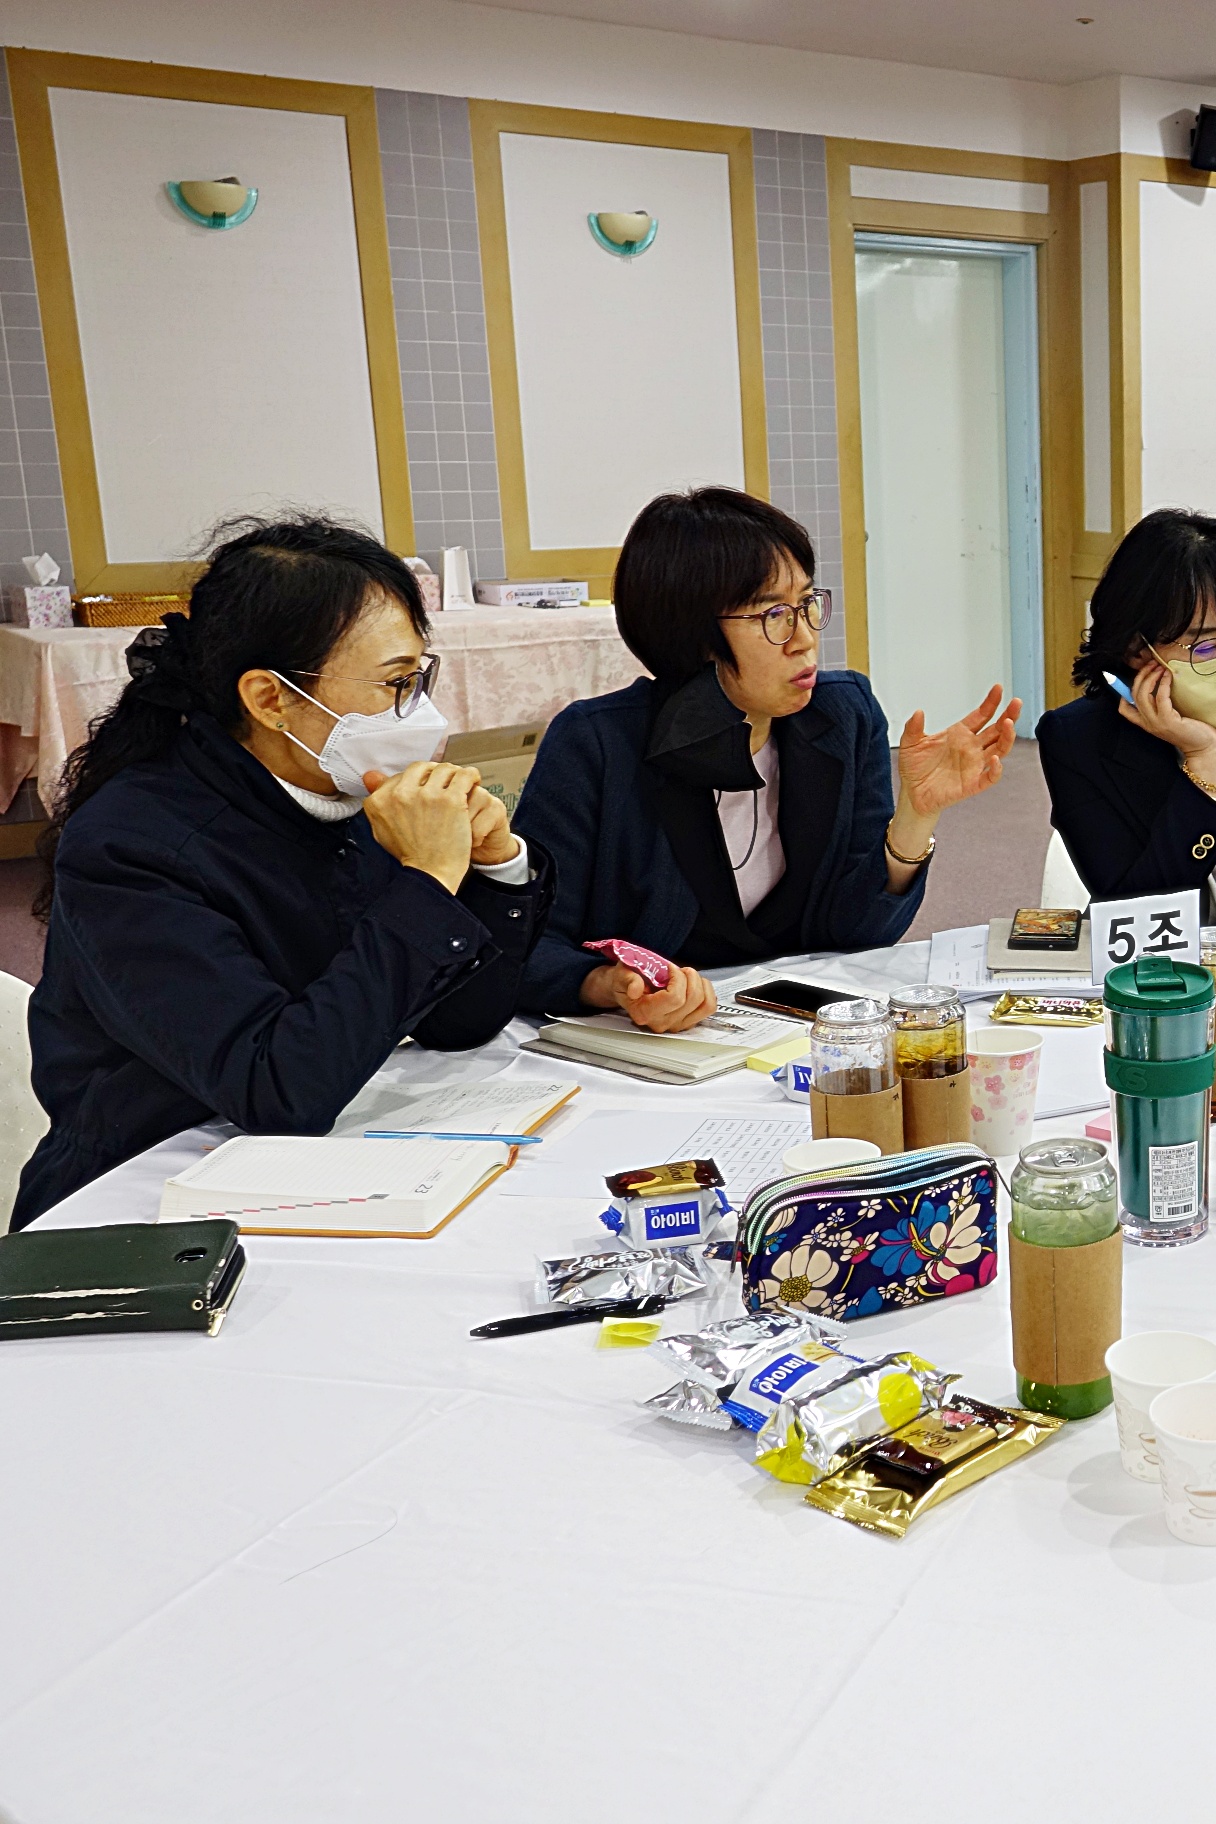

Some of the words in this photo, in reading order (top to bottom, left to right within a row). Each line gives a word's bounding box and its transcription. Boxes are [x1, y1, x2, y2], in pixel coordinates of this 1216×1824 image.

[1107, 909, 1189, 964] 5조
[651, 1209, 695, 1229] 아이비
[758, 1357, 808, 1393] 아이비
